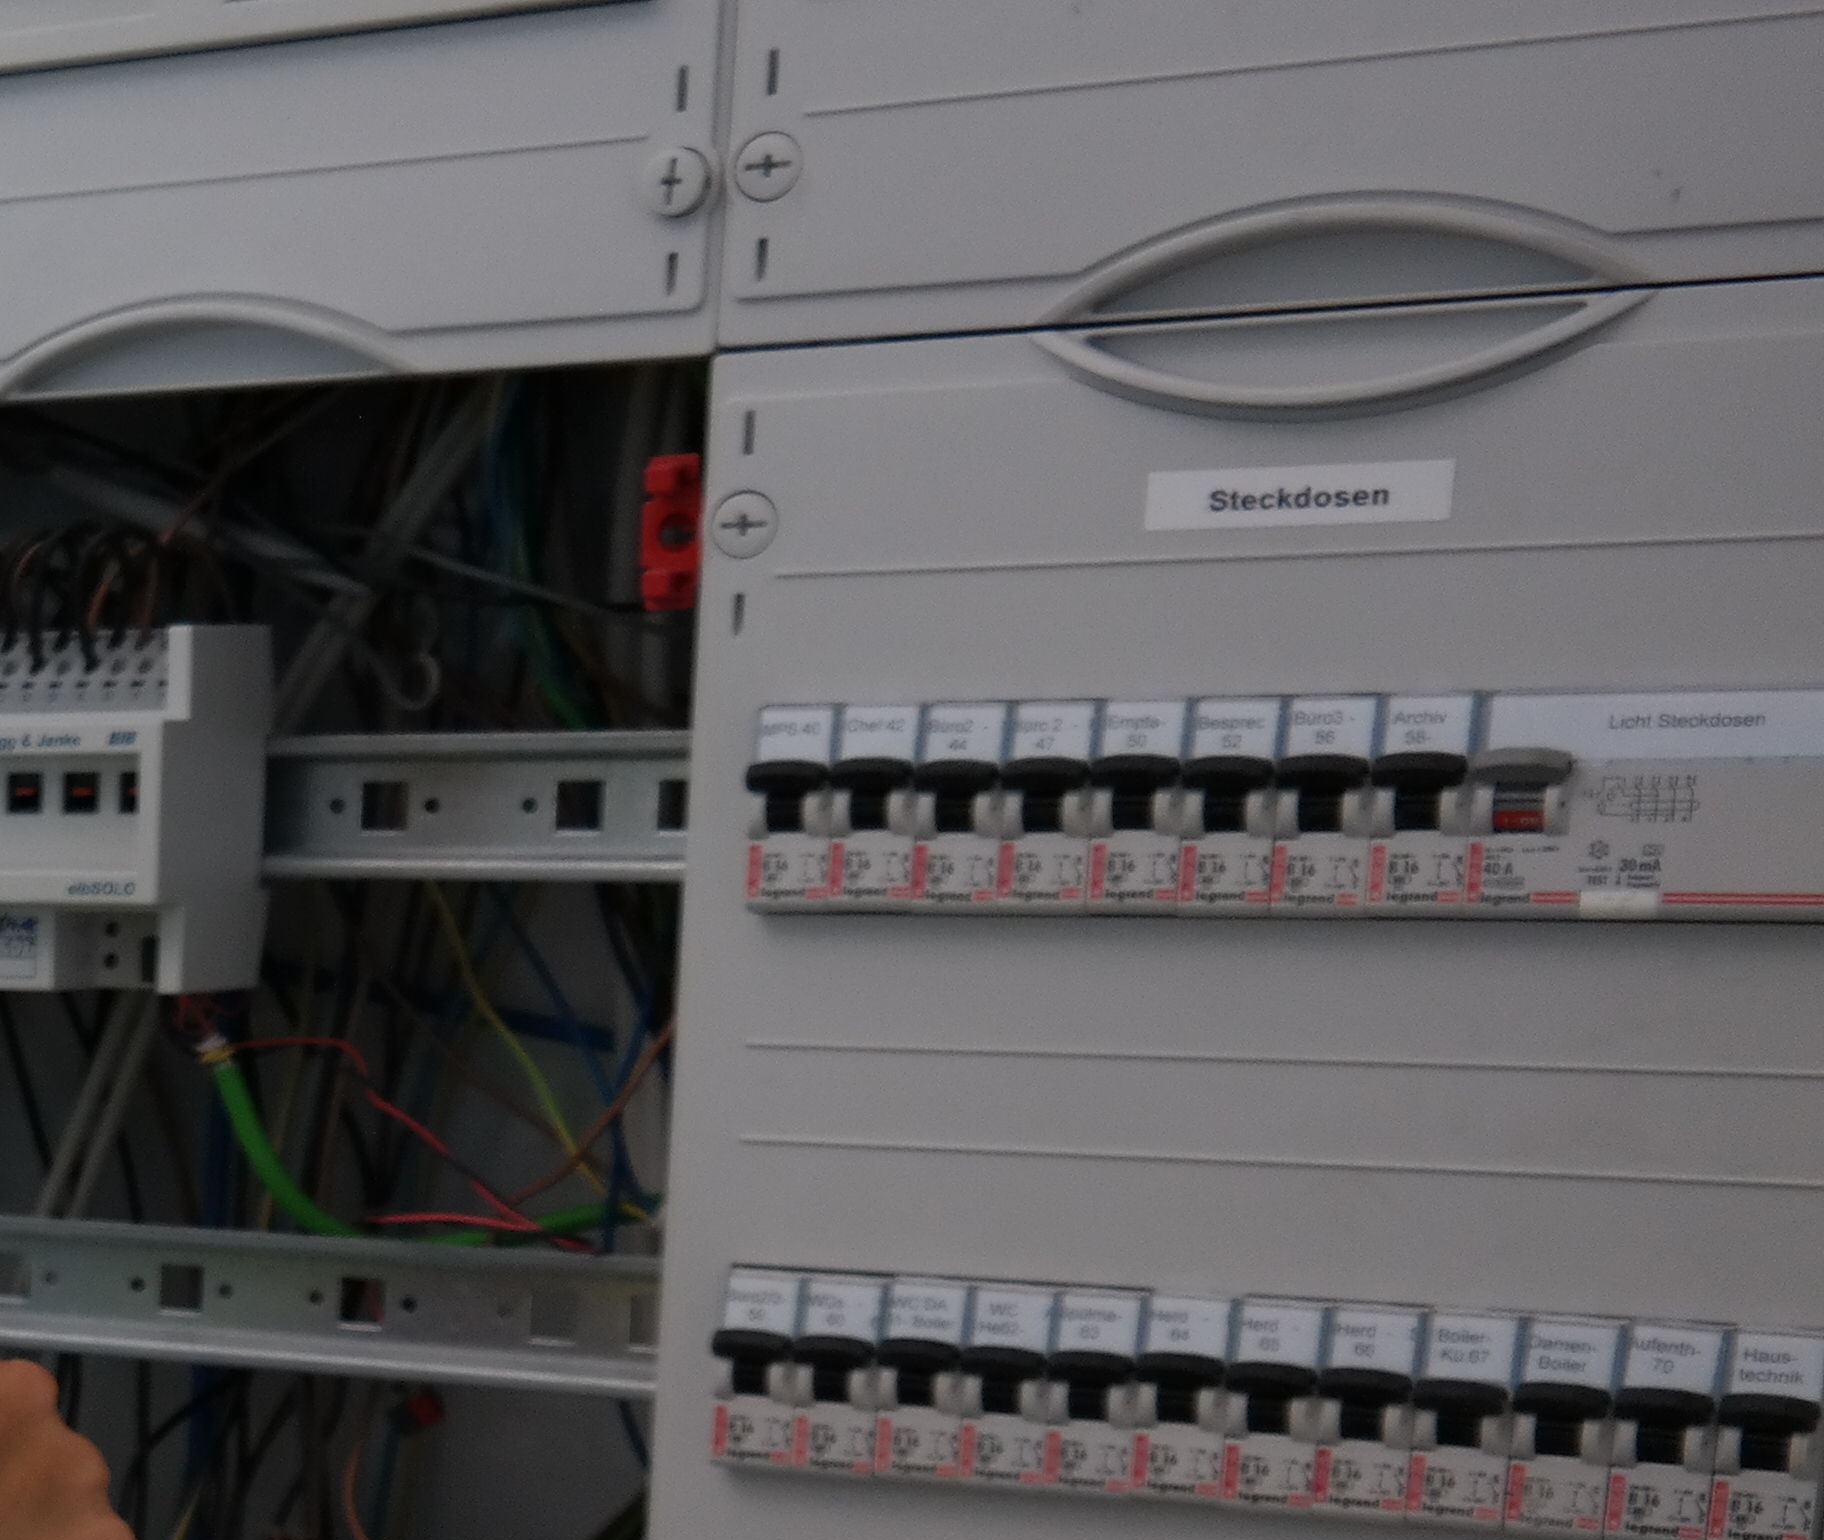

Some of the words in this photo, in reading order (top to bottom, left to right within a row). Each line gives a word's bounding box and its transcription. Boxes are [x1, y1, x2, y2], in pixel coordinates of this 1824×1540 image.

[1209, 486, 1390, 512] Steckdosen
[1393, 709, 1448, 726] Archiv
[1608, 713, 1652, 730] Licht
[1657, 712, 1767, 729] Steckdosen
[1742, 1346, 1799, 1365] Haus-
[1739, 1367, 1805, 1387] technik
[1625, 1521, 1679, 1540] legrand
